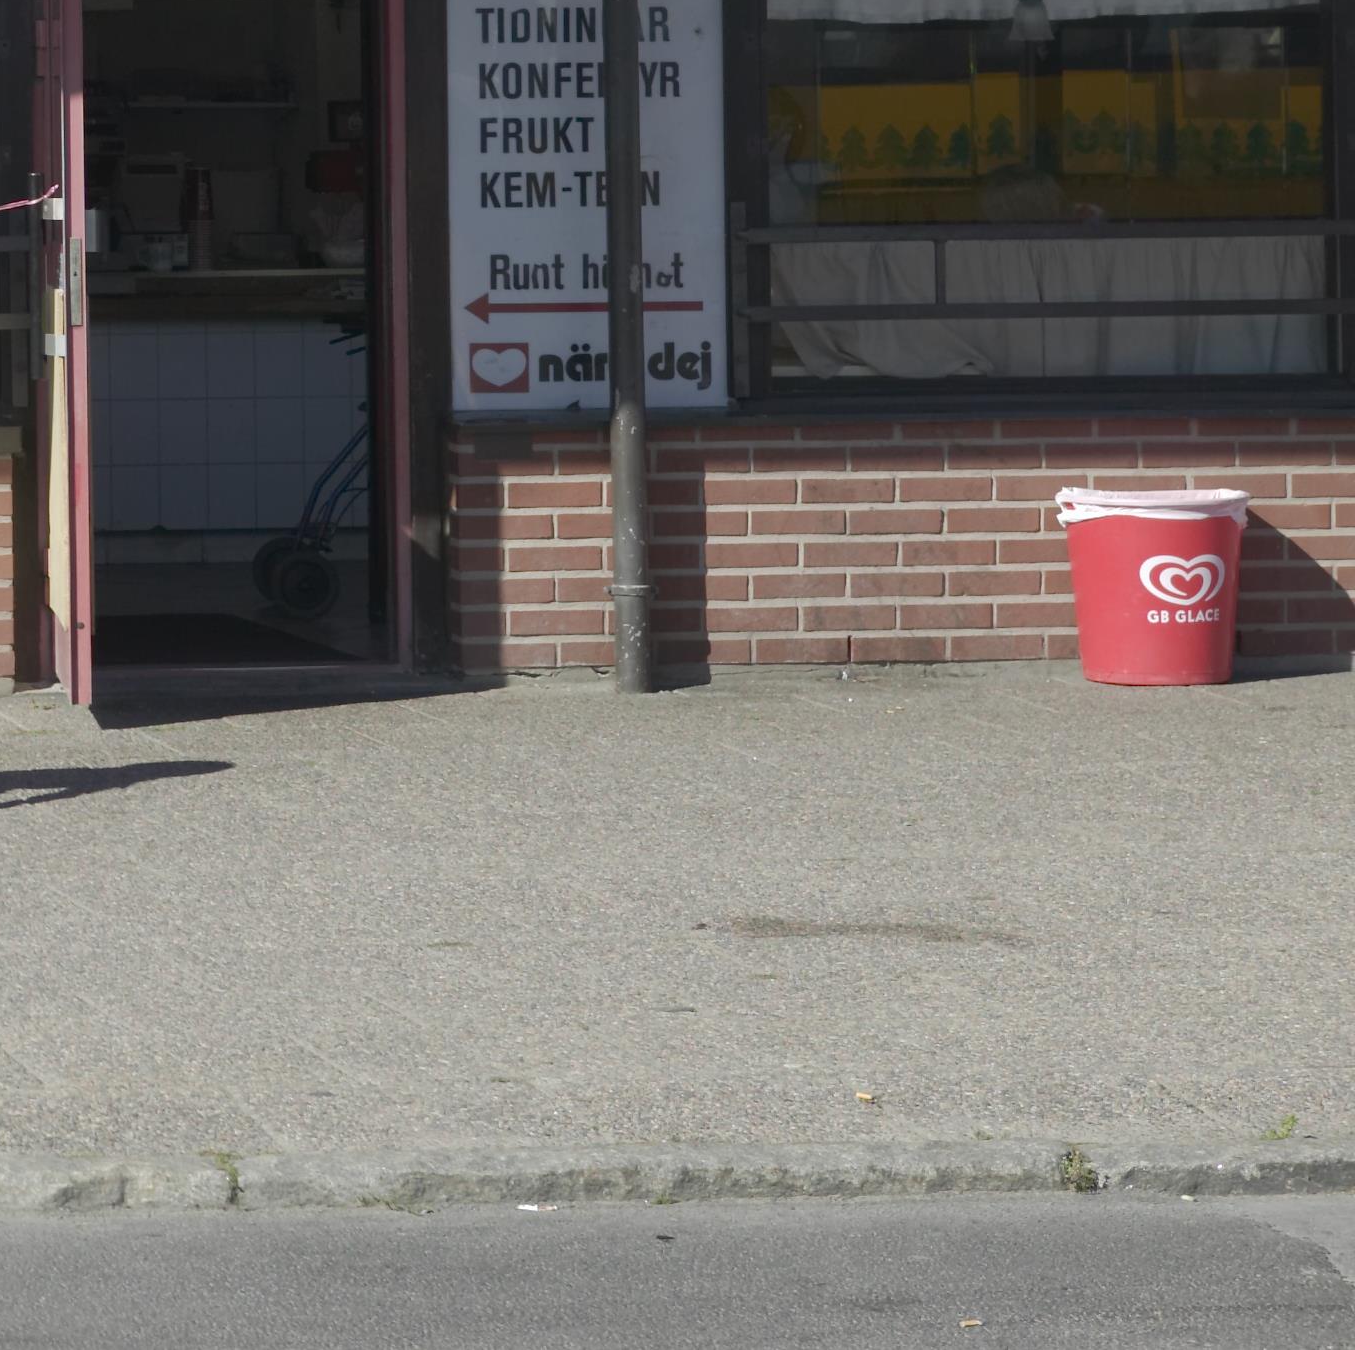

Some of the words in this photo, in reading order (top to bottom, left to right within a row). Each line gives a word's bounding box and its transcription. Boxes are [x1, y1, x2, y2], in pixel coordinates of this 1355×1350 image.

[475, 6, 670, 43] TIDNINR
[479, 61, 681, 99] KONFEYR
[480, 117, 595, 153] FRUKT
[480, 171, 660, 208] KEM-TEN
[490, 254, 565, 290] Runt
[539, 343, 610, 382] när
[647, 341, 712, 390] dej
[1147, 610, 1169, 623] GB
[1175, 609, 1220, 623] GLACE
